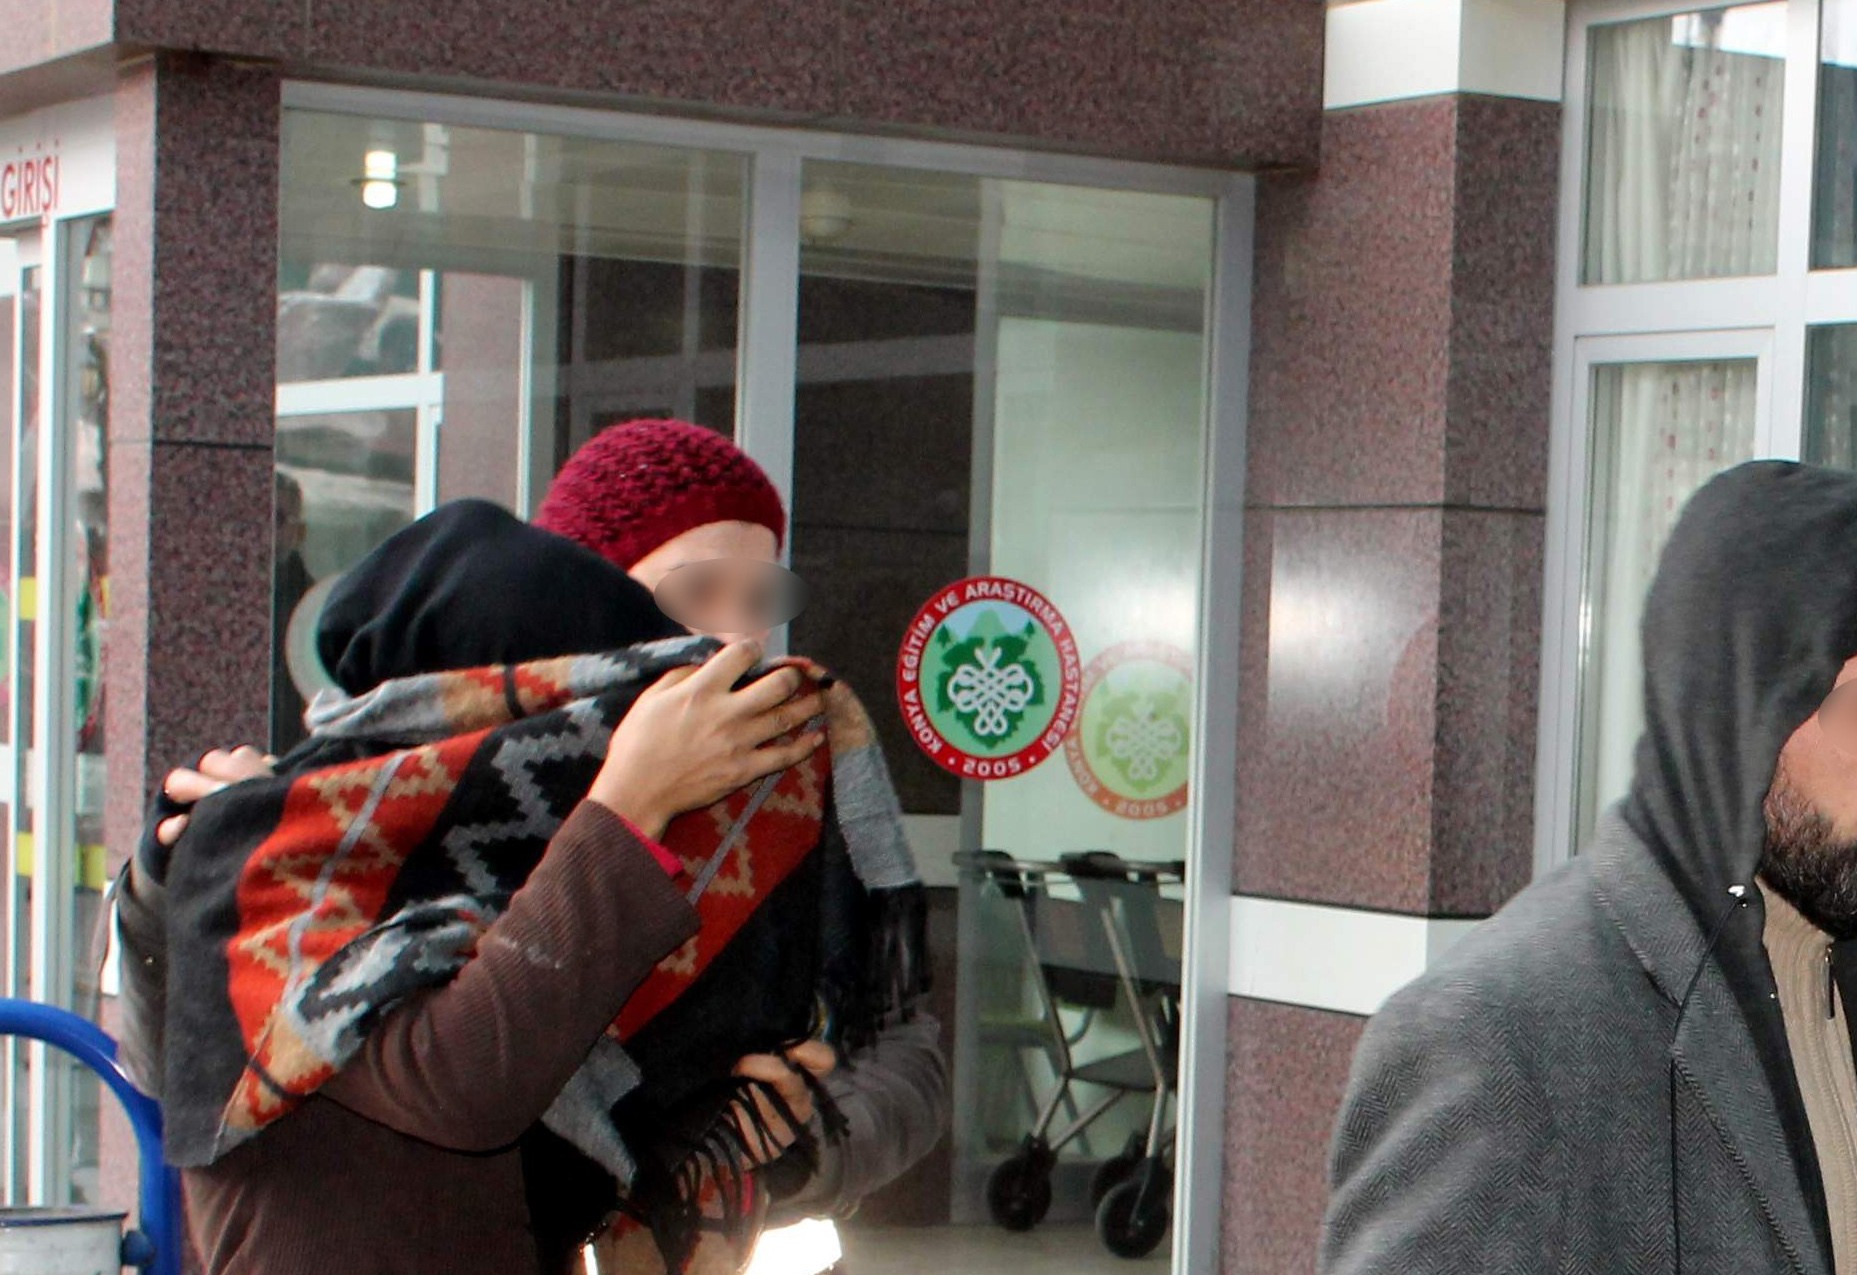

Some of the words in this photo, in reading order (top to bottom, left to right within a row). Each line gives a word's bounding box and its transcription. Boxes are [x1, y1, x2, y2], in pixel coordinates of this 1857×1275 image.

[904, 688, 943, 754] KONYA
[934, 590, 960, 614] VE
[963, 757, 1021, 777] 2005
